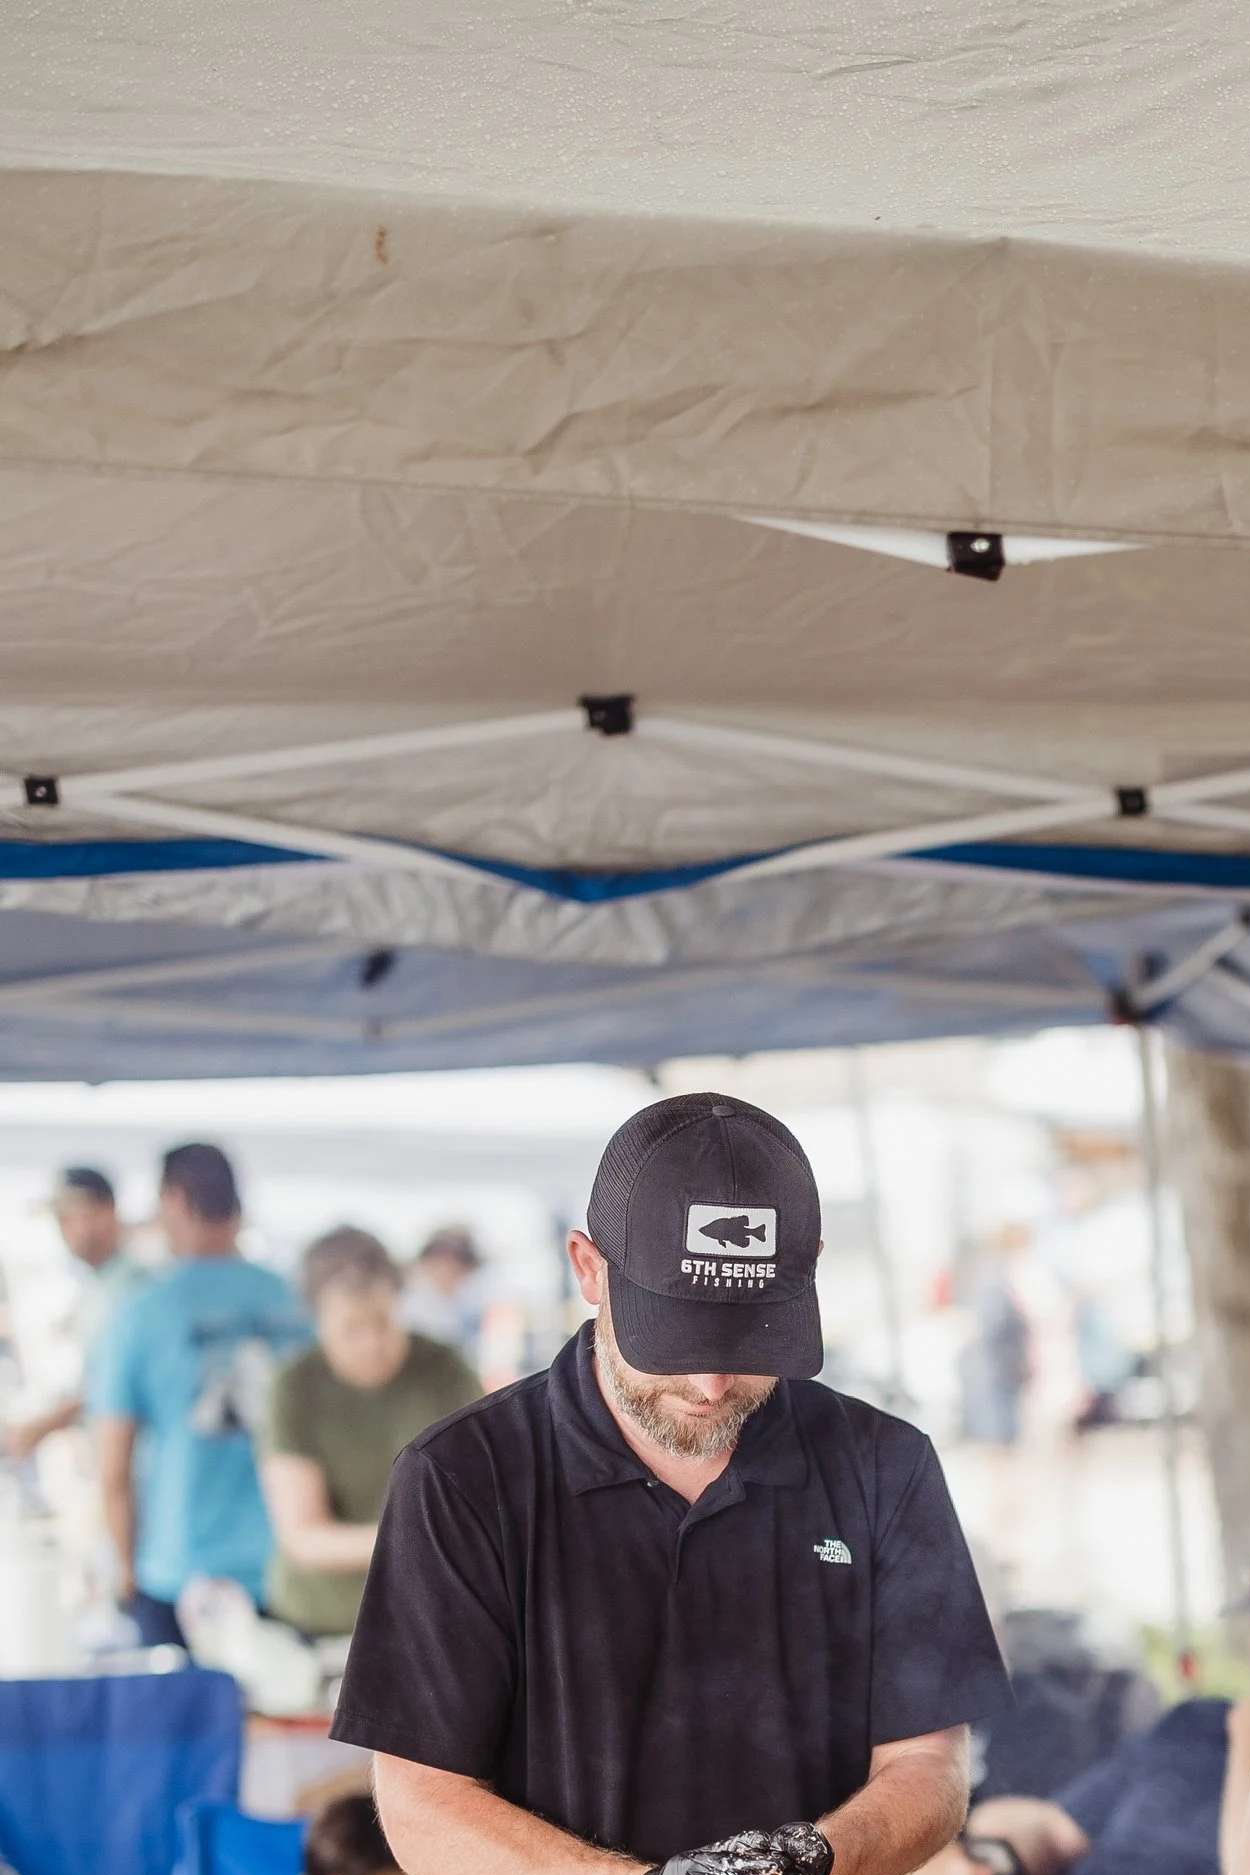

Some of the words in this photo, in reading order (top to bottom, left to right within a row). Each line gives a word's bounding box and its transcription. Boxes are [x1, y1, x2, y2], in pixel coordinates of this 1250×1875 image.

[681, 1259, 717, 1276] 6TH
[721, 1263, 776, 1278] SENSE
[692, 1275, 764, 1288] FISHING
[823, 1539, 841, 1548] THE
[813, 1544, 841, 1556] NORTH
[820, 1553, 841, 1563] FACE
